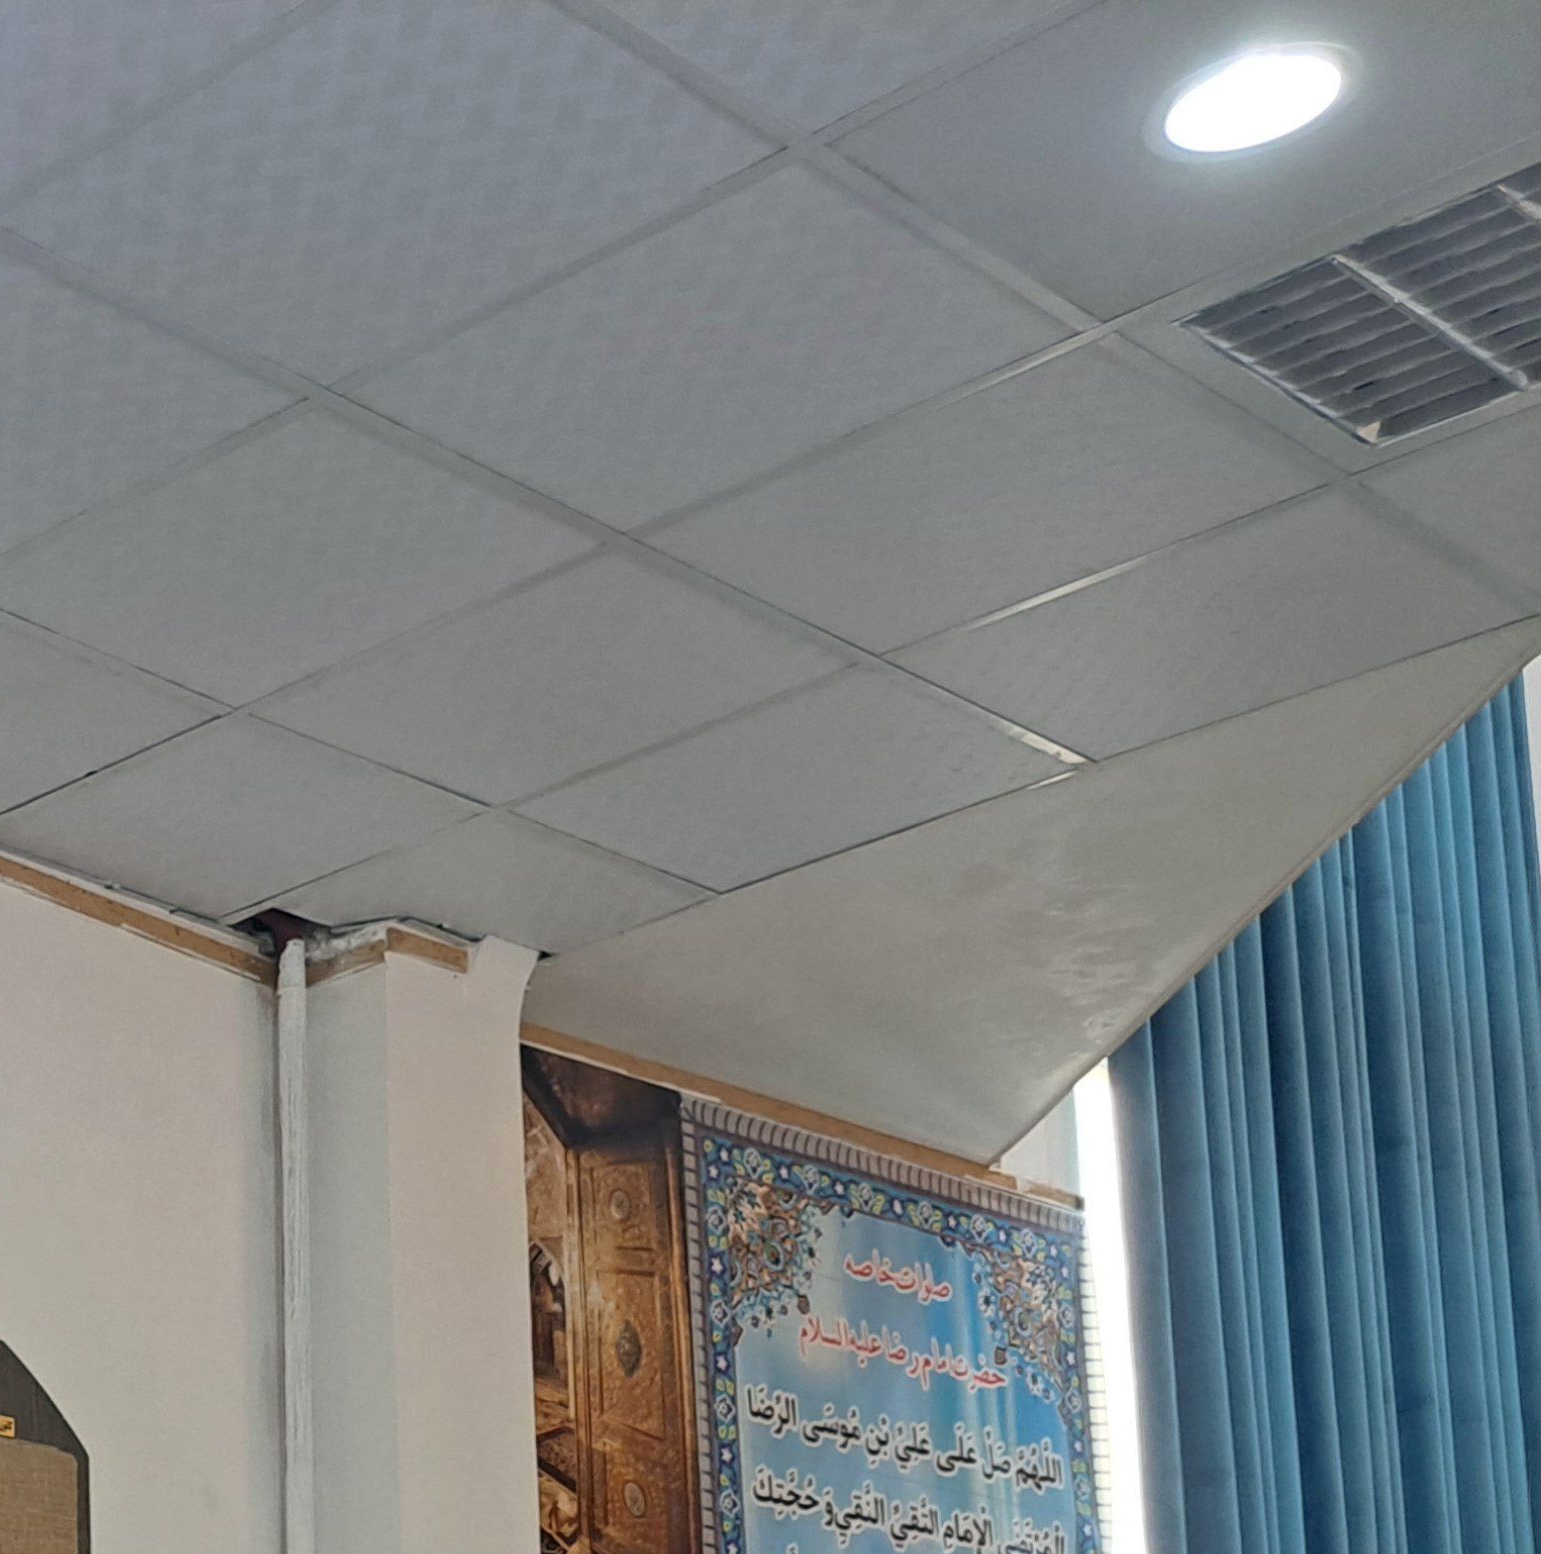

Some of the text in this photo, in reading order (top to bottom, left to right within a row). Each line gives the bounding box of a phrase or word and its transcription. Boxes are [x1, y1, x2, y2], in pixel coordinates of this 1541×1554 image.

[845, 1249, 952, 1304] صلوات خاصه
[884, 1327, 920, 1377] رضا
[923, 1338, 953, 1390] امام
[953, 1357, 1006, 1392] حضرت
